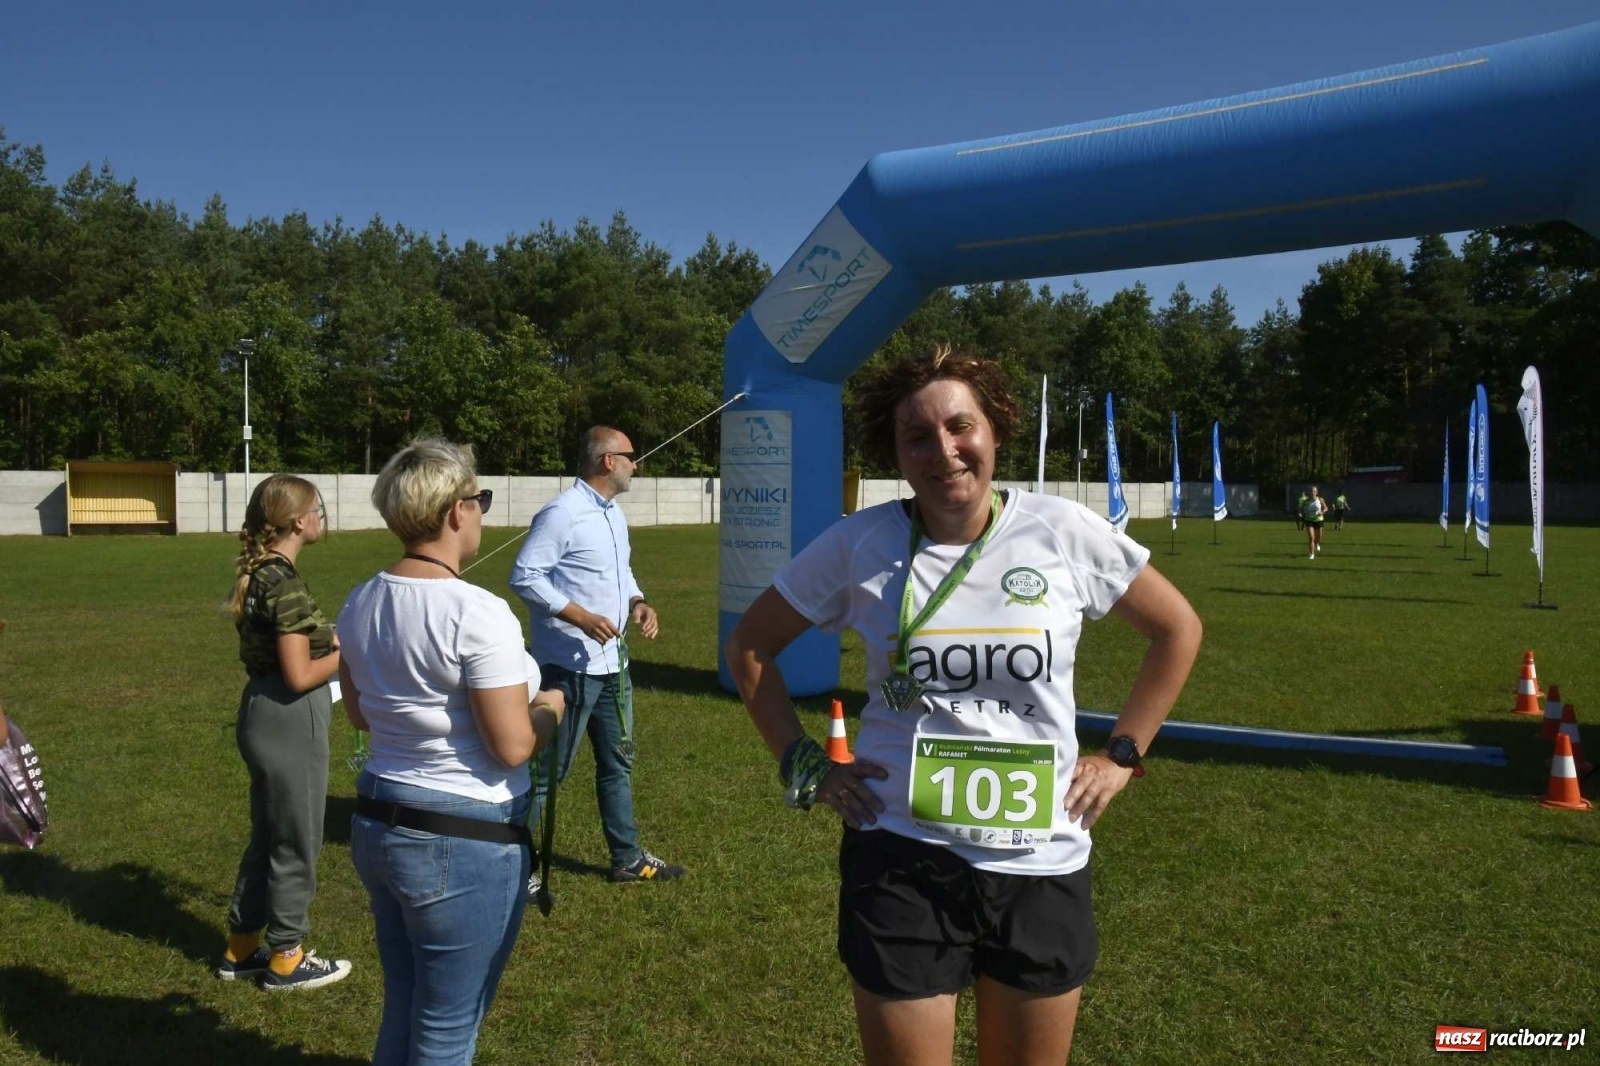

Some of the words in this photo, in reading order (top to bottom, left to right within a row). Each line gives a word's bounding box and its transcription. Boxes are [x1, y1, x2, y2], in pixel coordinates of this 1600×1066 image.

[777, 246, 871, 348] TIMESPORT
[909, 629, 1052, 694] agrol
[938, 751, 968, 759] RAFAMET
[929, 765, 1038, 823] 103
